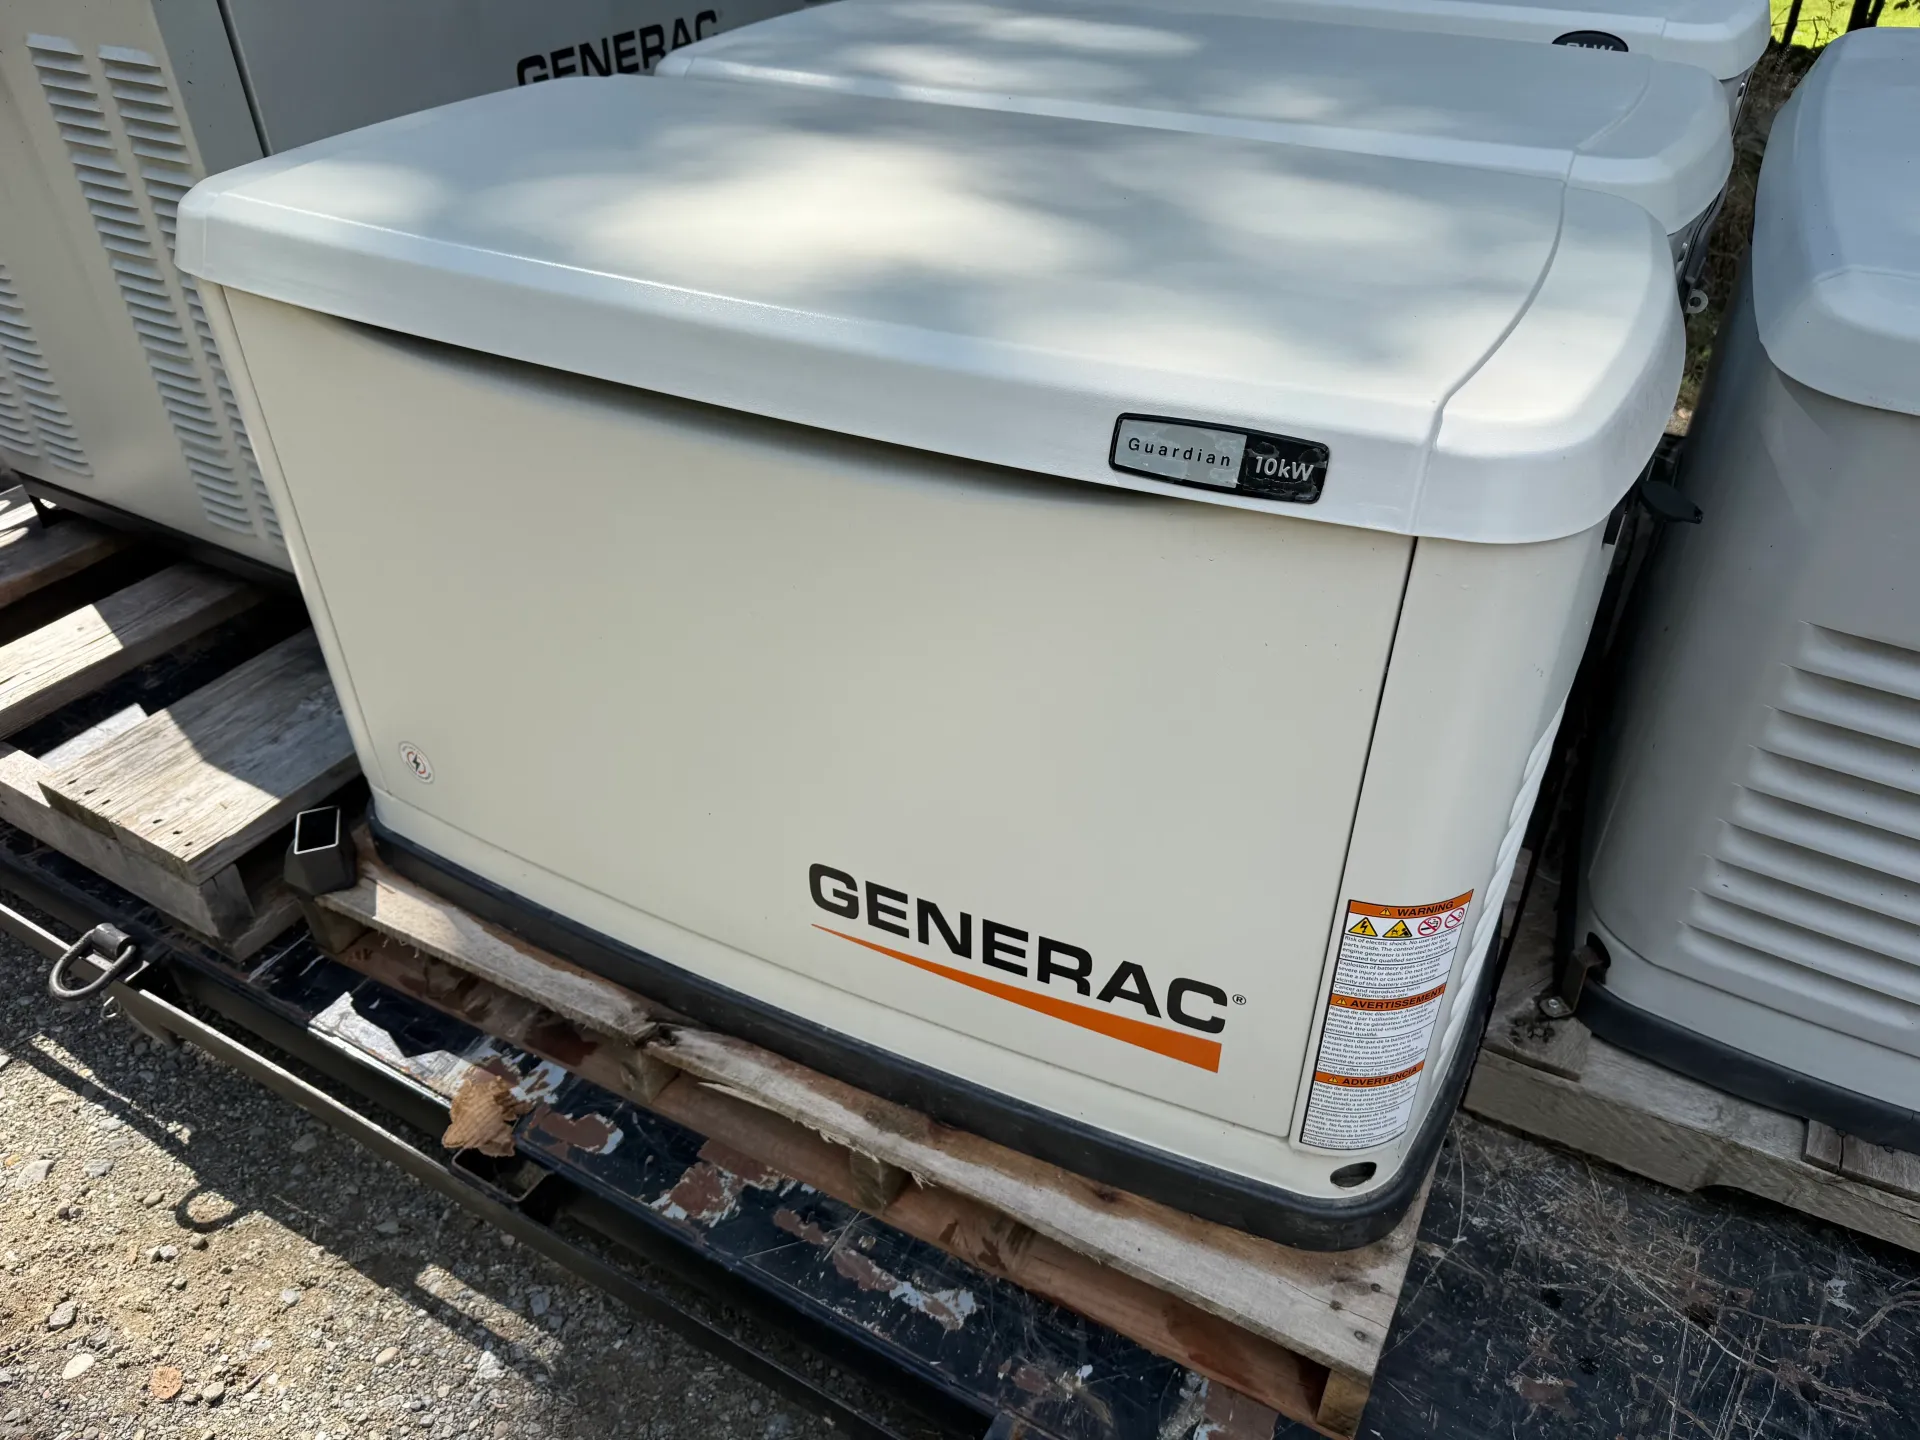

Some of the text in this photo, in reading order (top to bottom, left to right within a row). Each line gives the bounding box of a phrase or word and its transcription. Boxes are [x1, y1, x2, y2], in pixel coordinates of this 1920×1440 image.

[1128, 437, 1315, 482] Guardian 10kW
[1397, 901, 1454, 916] WARNING
[809, 863, 1228, 1034] GENERAC
[1340, 952, 1368, 961] operated
[1334, 983, 1355, 991] Cancer
[1350, 987, 1444, 1009] AVERTISSEMENT
[1342, 1067, 1417, 1086] ADVERTENCIA
